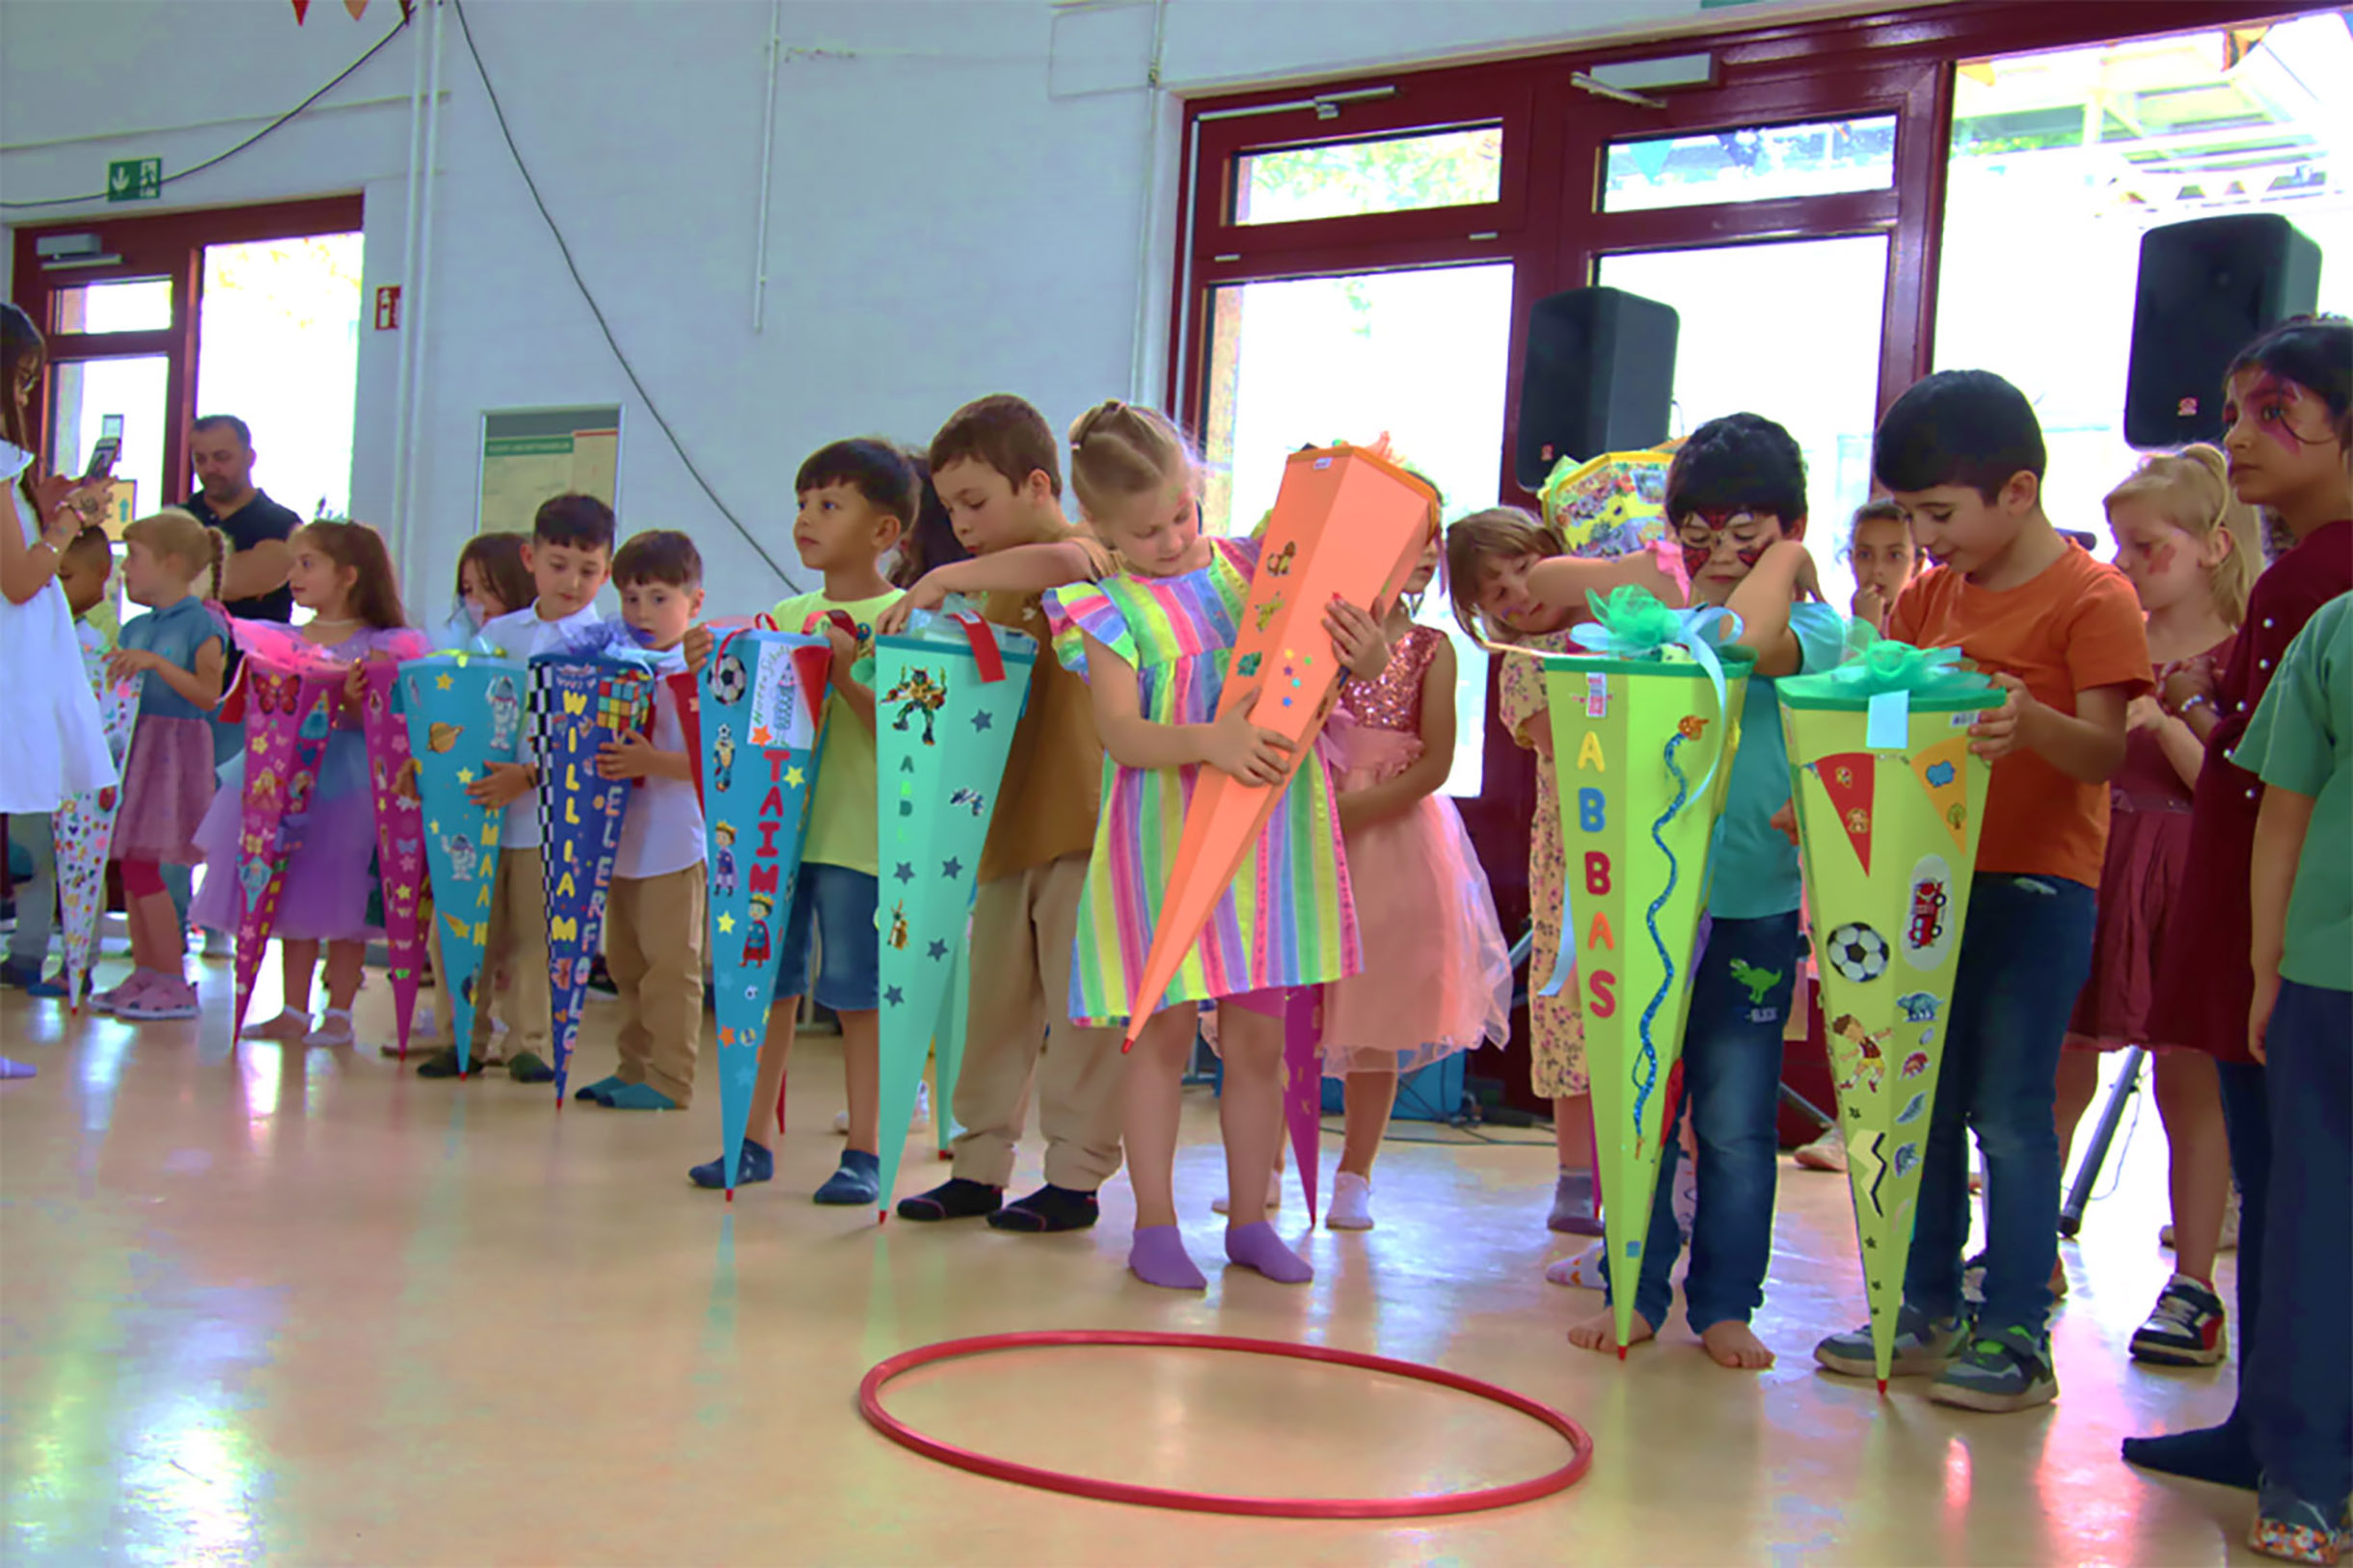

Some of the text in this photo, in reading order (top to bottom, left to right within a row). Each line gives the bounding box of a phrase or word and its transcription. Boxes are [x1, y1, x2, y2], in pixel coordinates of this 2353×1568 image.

[552, 689, 587, 942] WILLIAM
[748, 749, 791, 895] TAIM
[1577, 731, 1616, 1018] ABBAS
